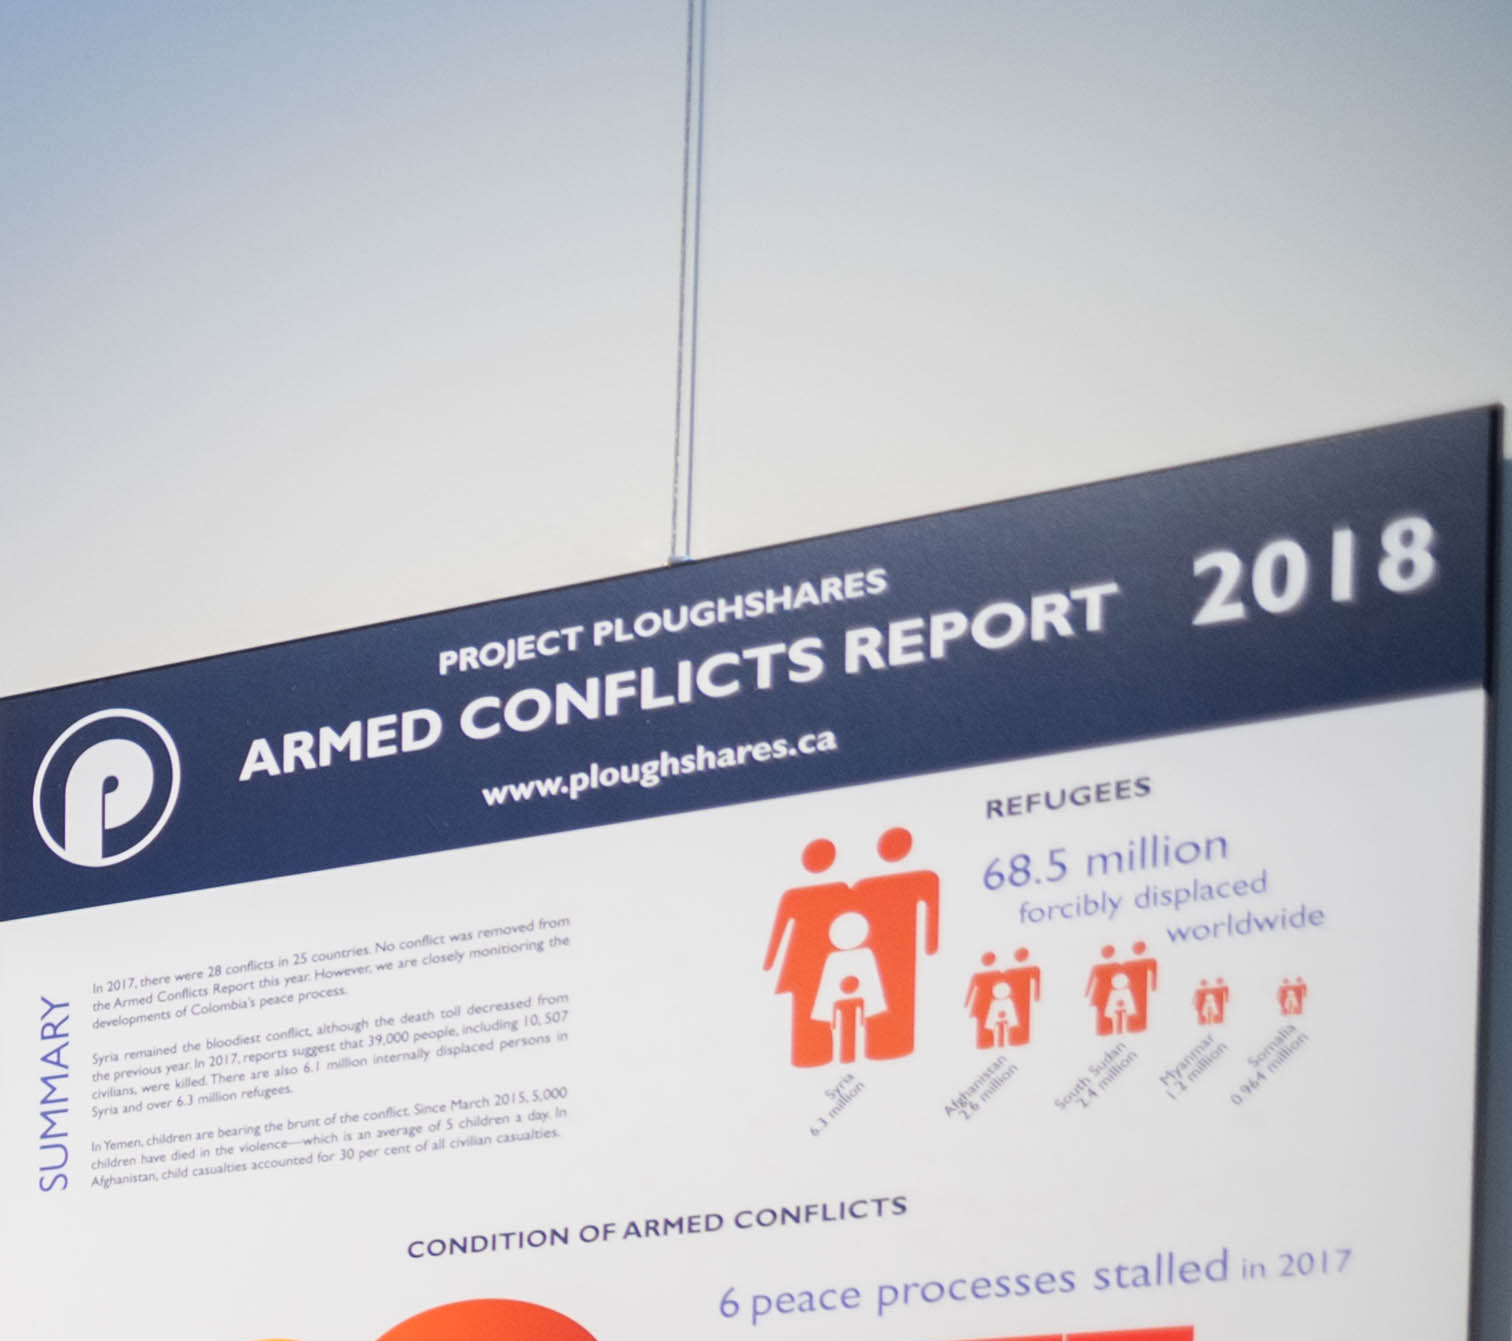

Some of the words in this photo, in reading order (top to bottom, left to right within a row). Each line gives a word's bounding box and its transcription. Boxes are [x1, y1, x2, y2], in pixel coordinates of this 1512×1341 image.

[1191, 514, 1440, 628] 2018
[440, 626, 584, 675] PROJECT
[594, 568, 887, 646] PLOUGHSHARES
[240, 709, 442, 781] ARMED
[461, 637, 824, 739] CONFLICTS
[845, 582, 1119, 673] REPORT
[482, 732, 837, 805] www.ploughshares.ca
[987, 777, 1150, 818] REFUGEES
[984, 849, 1067, 890] 68.5
[1088, 835, 1227, 876] million
[1020, 891, 1122, 923] forcibly
[1135, 869, 1267, 910] displaced
[1167, 904, 1324, 942] worldwide
[39, 996, 71, 1192] SUMMARY
[408, 1228, 568, 1258] CONDITION
[580, 1223, 615, 1243] OF
[623, 1214, 723, 1239] ARMED
[735, 1197, 907, 1229] CONFLICTS
[720, 1288, 739, 1318] 6
[752, 1288, 860, 1325] peace
[878, 1271, 1075, 1316] processes
[1094, 1249, 1228, 1290] stalled
[1242, 1256, 1267, 1280] in
[1281, 1249, 1352, 1276] 2017
